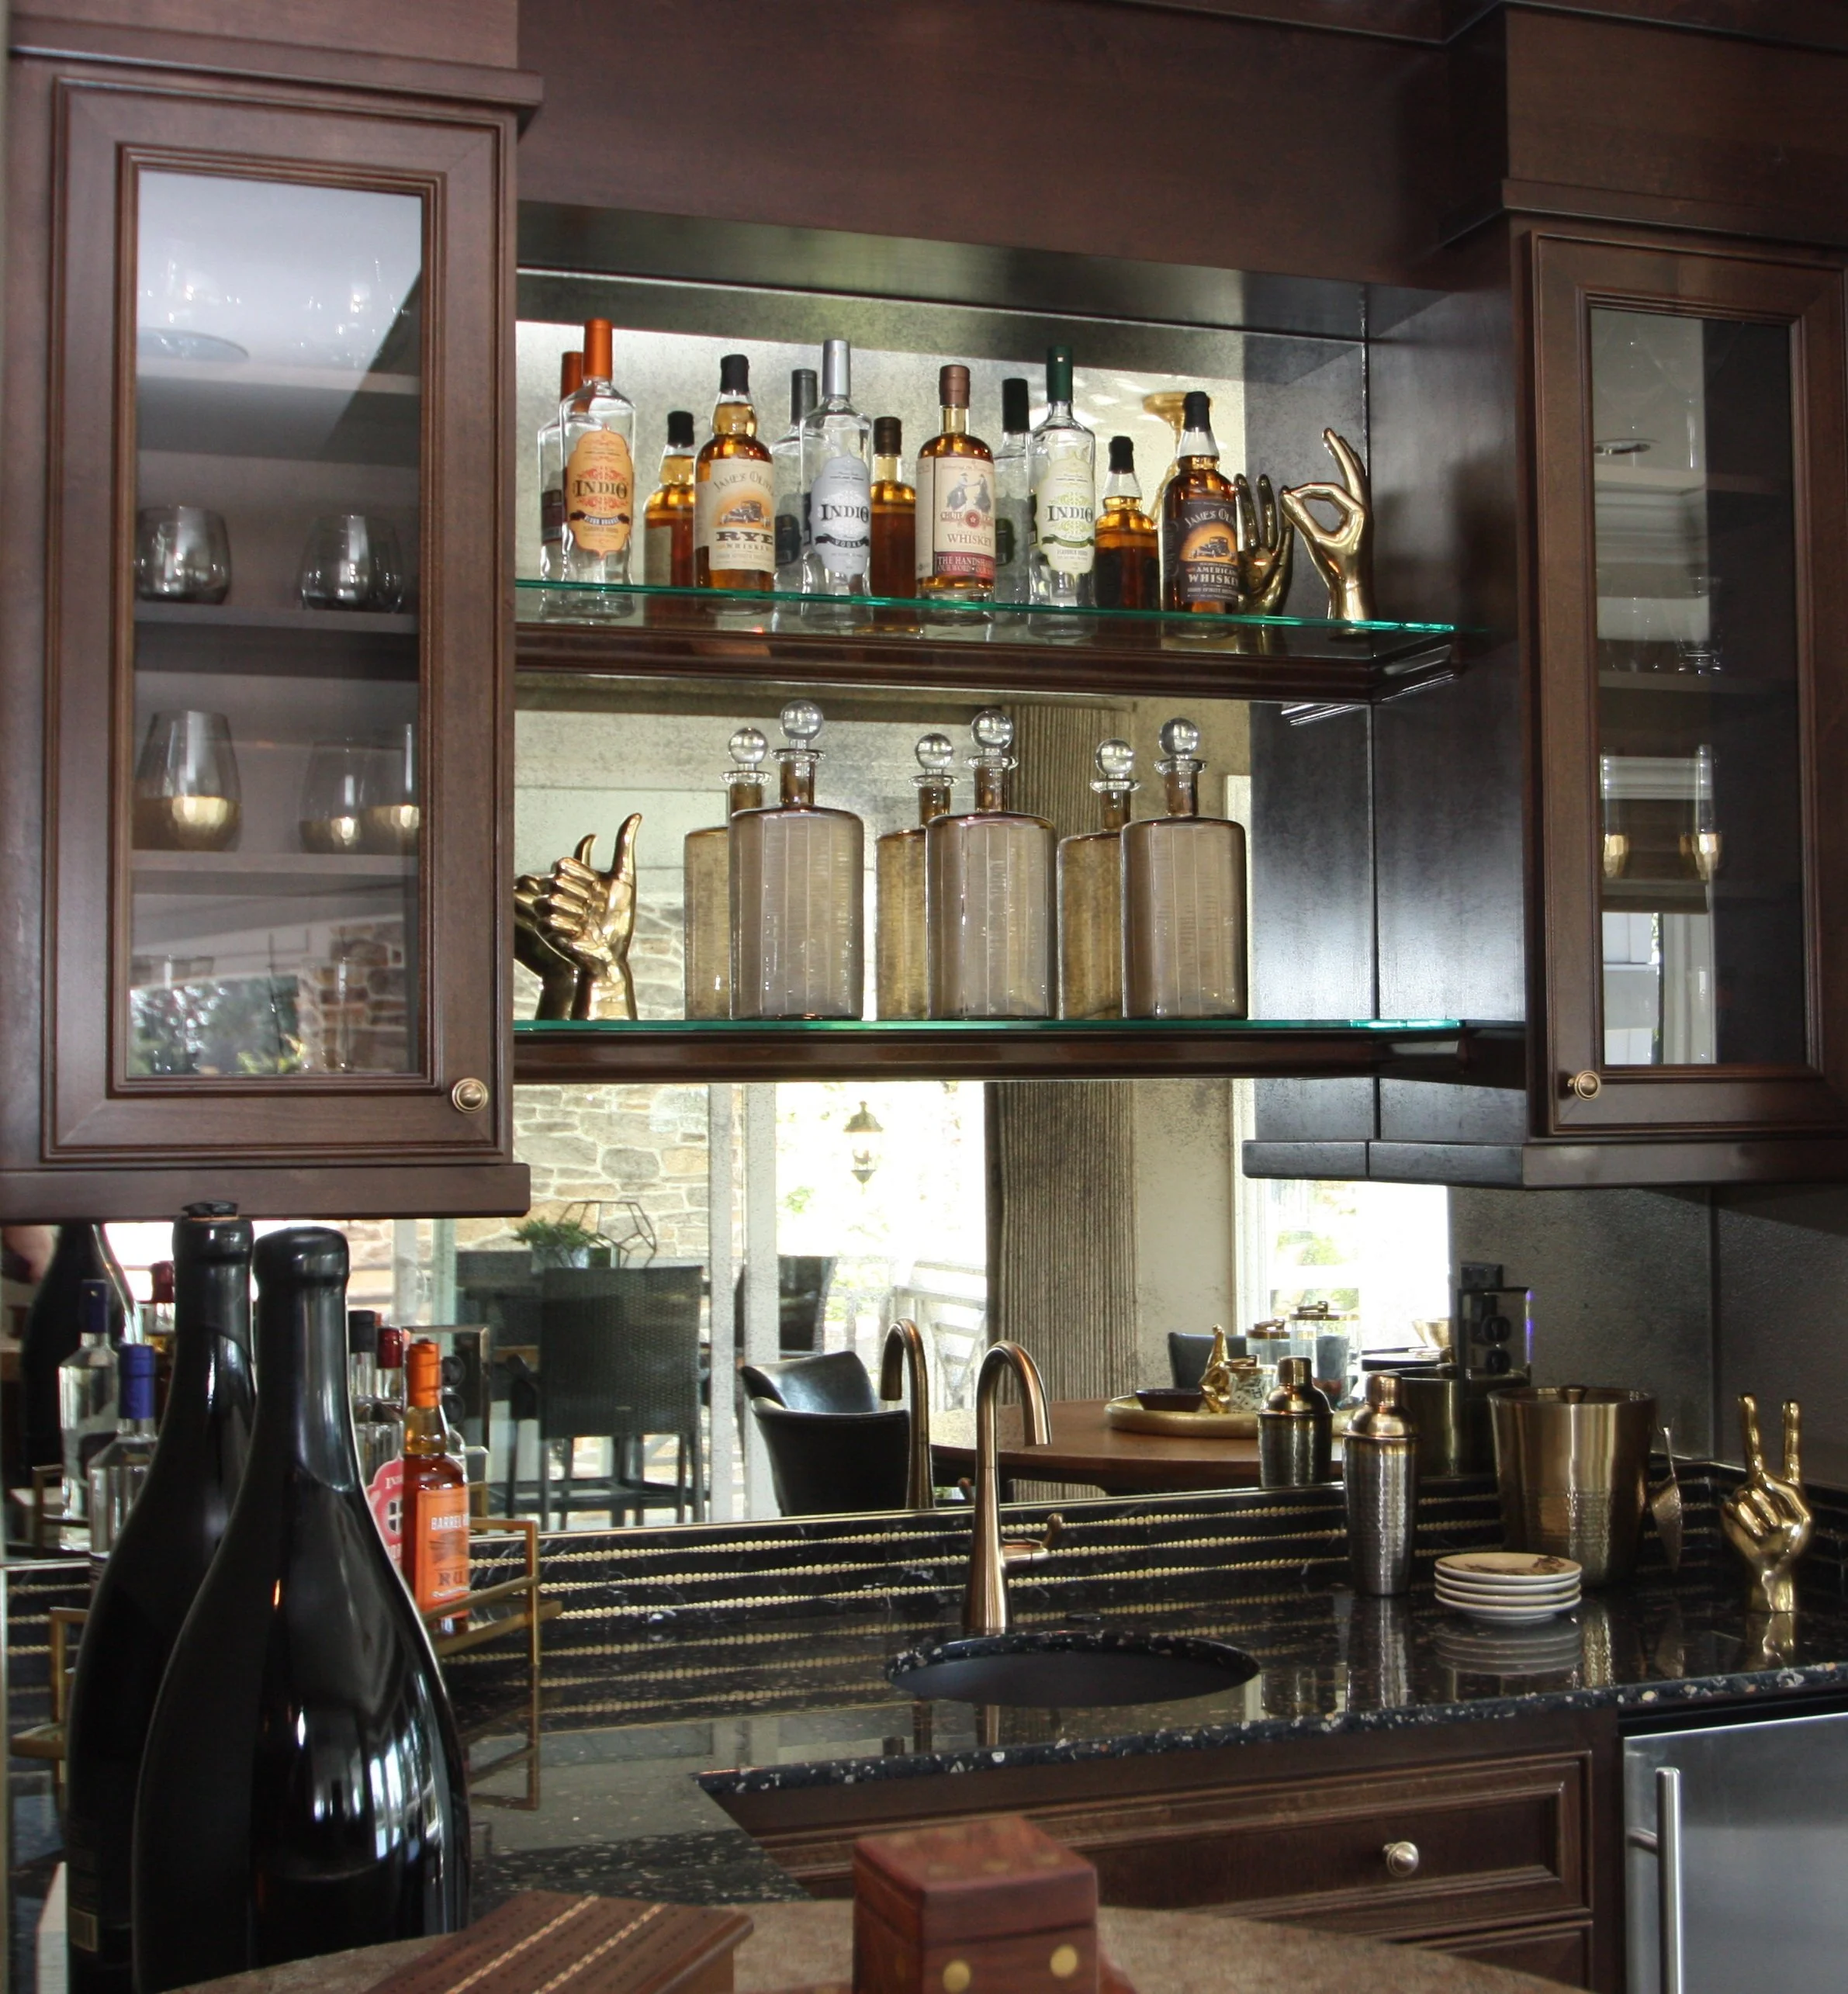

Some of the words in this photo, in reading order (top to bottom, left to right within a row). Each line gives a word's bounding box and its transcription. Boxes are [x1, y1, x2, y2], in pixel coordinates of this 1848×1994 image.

[574, 479, 628, 499] INDIO
[820, 504, 869, 523] INDIO
[1047, 505, 1093, 523] INDIO
[1184, 510, 1216, 528] JAMES
[715, 531, 773, 545] RYE
[946, 533, 992, 548] WHISKEY
[937, 556, 953, 565] THE
[1188, 573, 1239, 587] WHISKEY
[431, 1516, 462, 1530] BARREL
